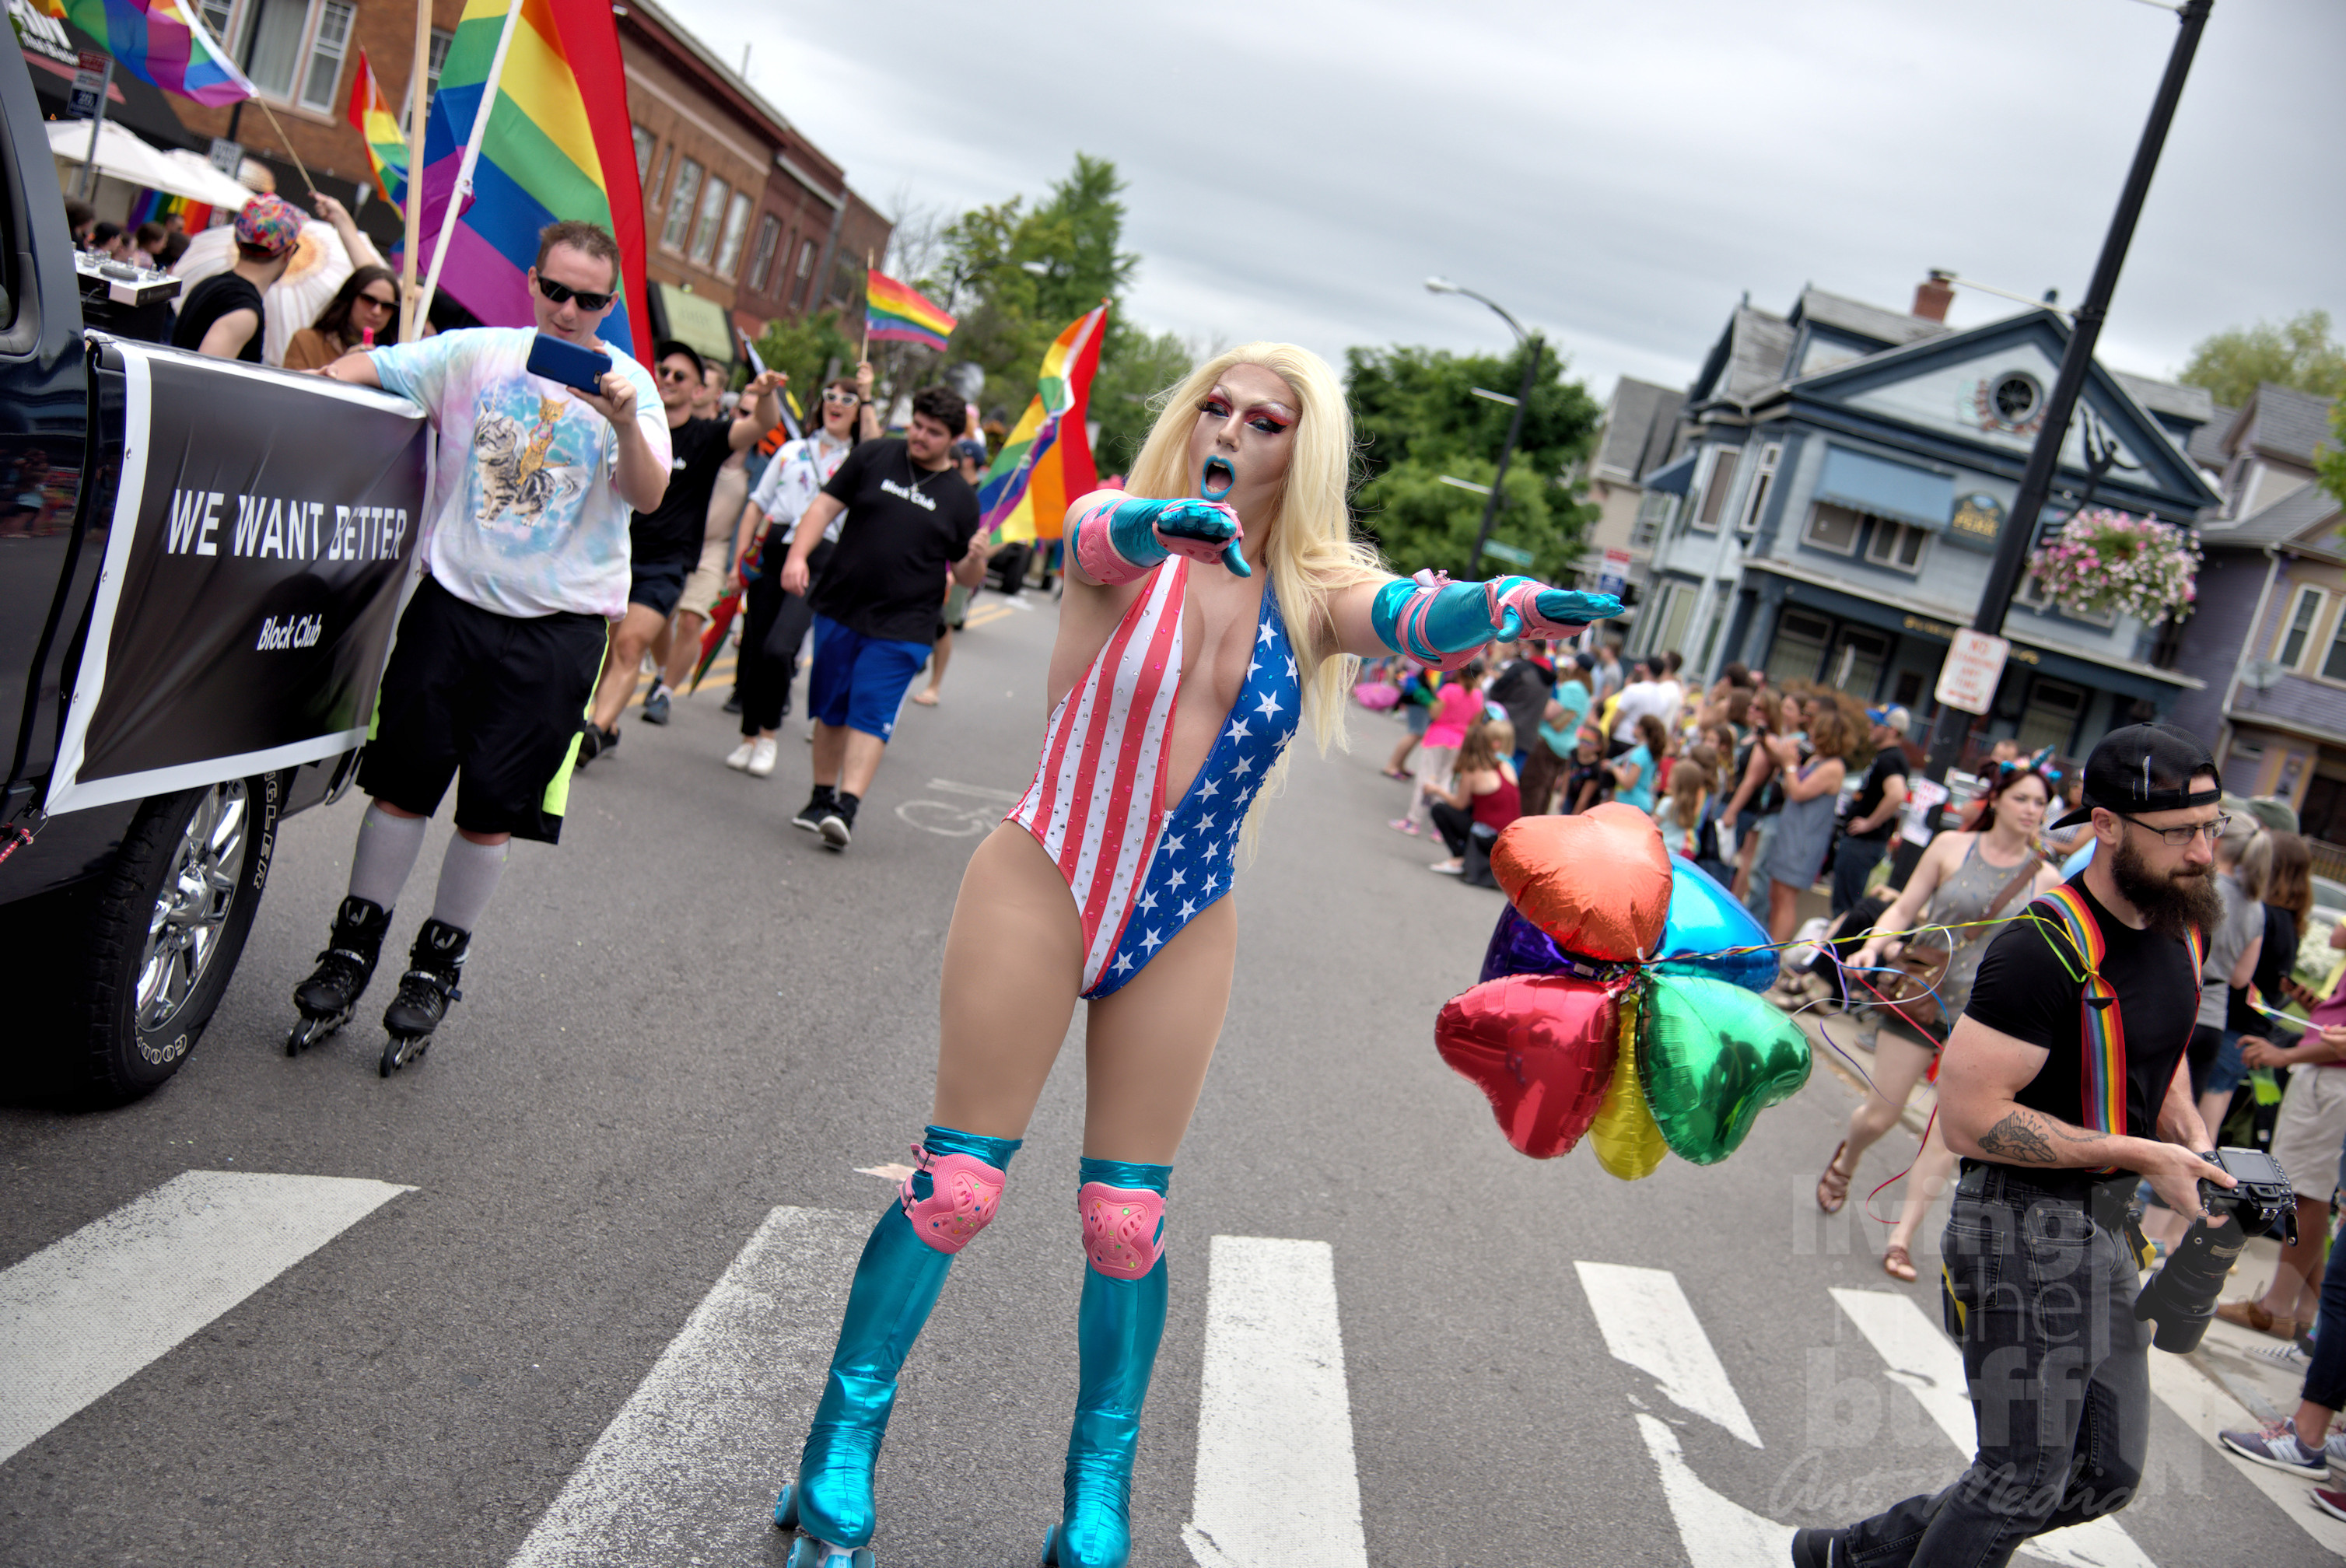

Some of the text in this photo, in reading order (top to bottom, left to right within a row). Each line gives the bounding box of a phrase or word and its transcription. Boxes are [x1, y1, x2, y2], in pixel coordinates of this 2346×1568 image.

[881, 479, 937, 511] Block Club
[168, 488, 408, 560] WE WANT BETTER
[256, 614, 322, 651] Block Club
[1968, 638, 1990, 656] NO
